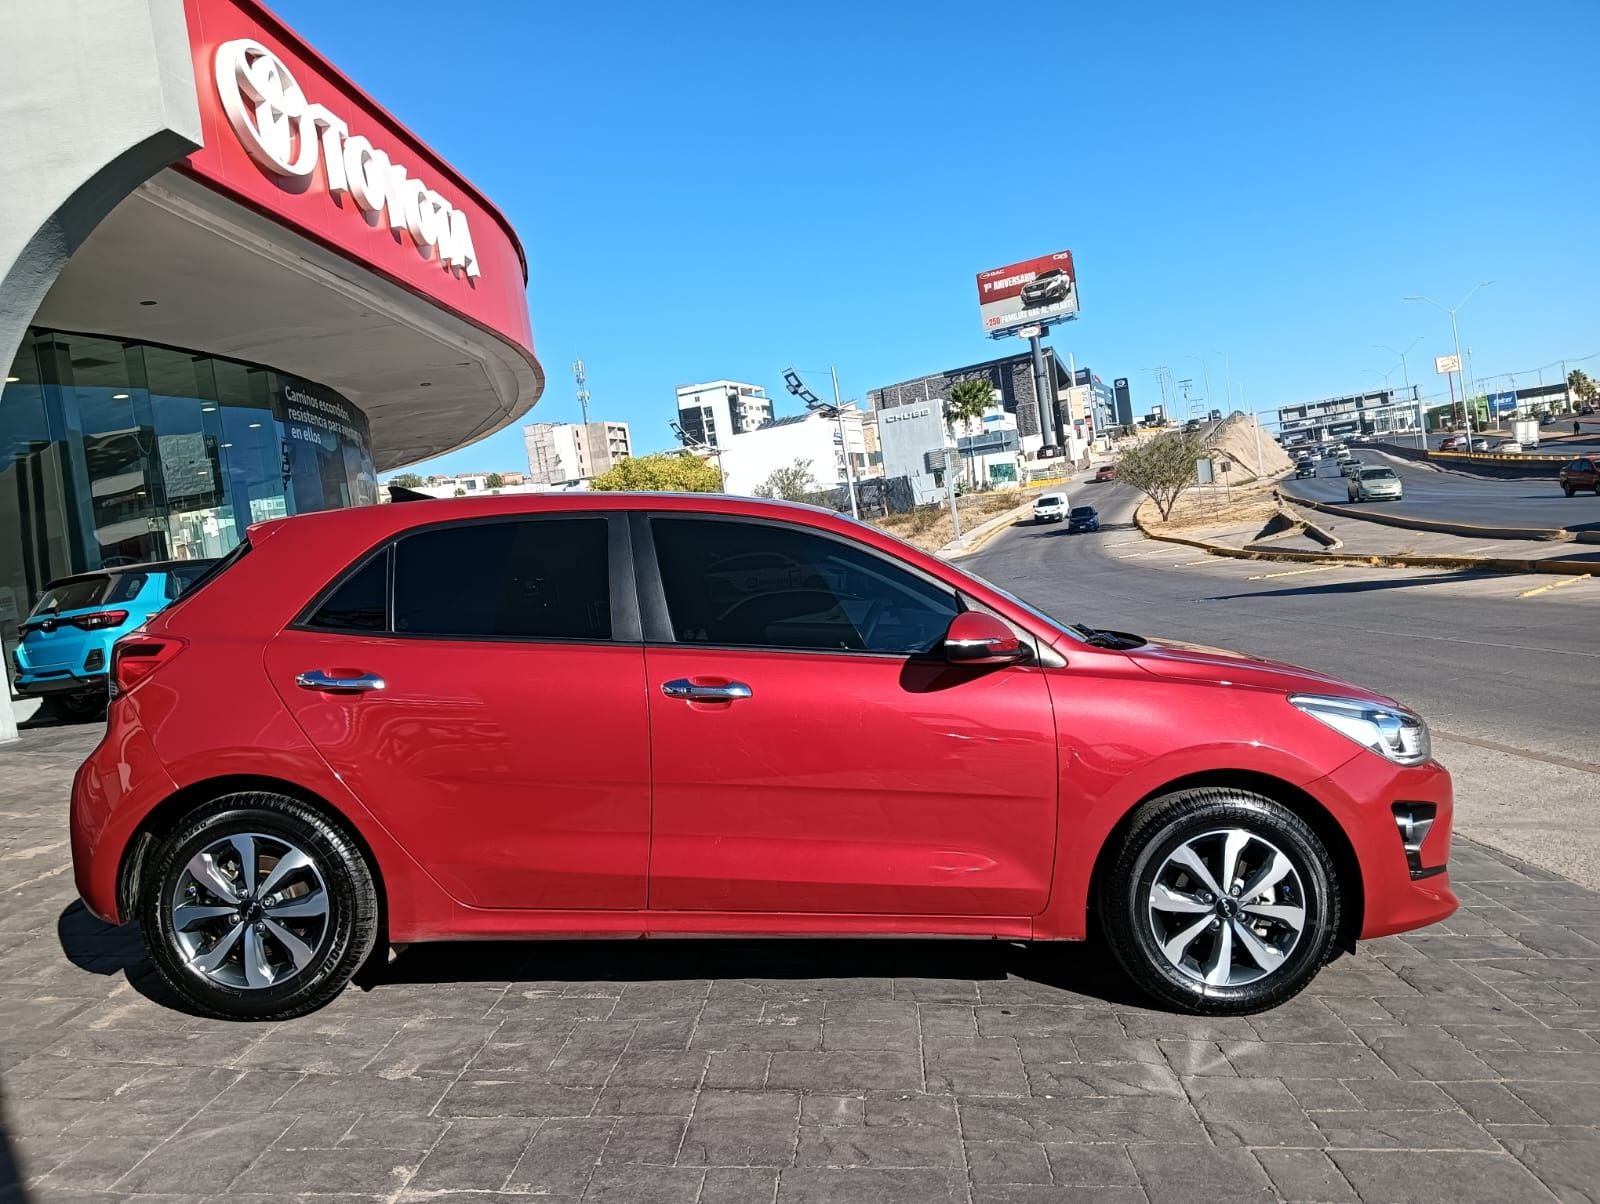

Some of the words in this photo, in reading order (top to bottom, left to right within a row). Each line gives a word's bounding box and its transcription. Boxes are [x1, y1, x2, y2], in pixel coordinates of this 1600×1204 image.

[307, 103, 481, 278] TOYOTA
[993, 271, 1036, 291] ANIVERSARIO
[285, 385, 318, 408] Caminos
[288, 406, 327, 429] resistencia
[328, 420, 341, 433] para
[291, 427, 302, 440] en
[304, 426, 321, 444] ellos
